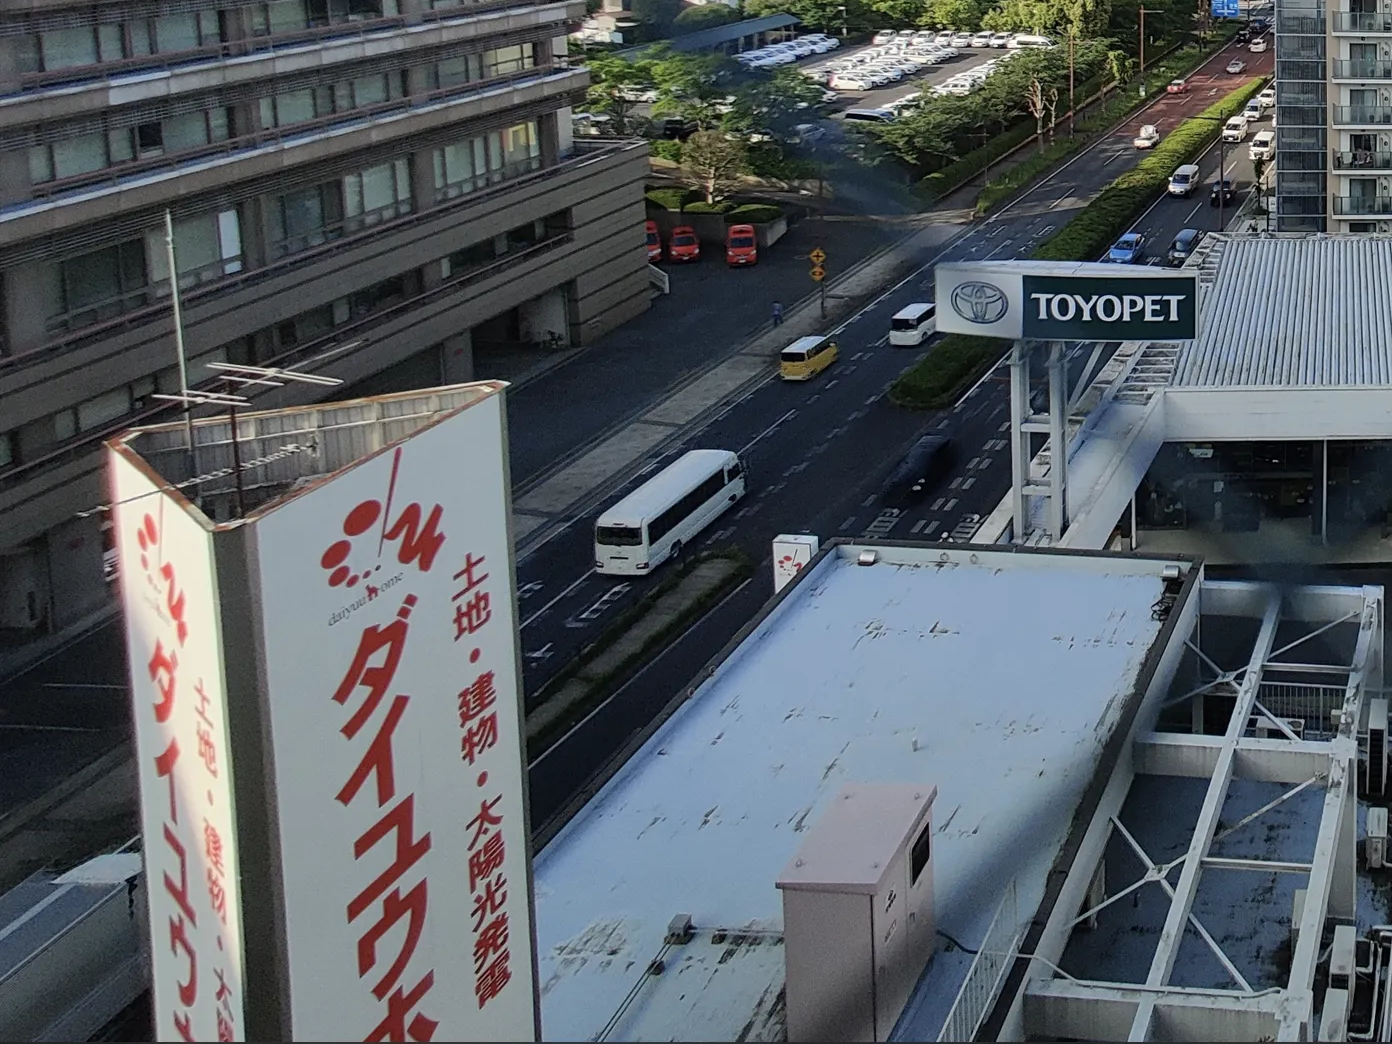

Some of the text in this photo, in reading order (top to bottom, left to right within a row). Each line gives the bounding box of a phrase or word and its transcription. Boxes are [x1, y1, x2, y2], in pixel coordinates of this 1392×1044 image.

[1030, 292, 1187, 323] TOYOPET
[452, 552, 513, 1009] 土地・建物・太陽光発電
